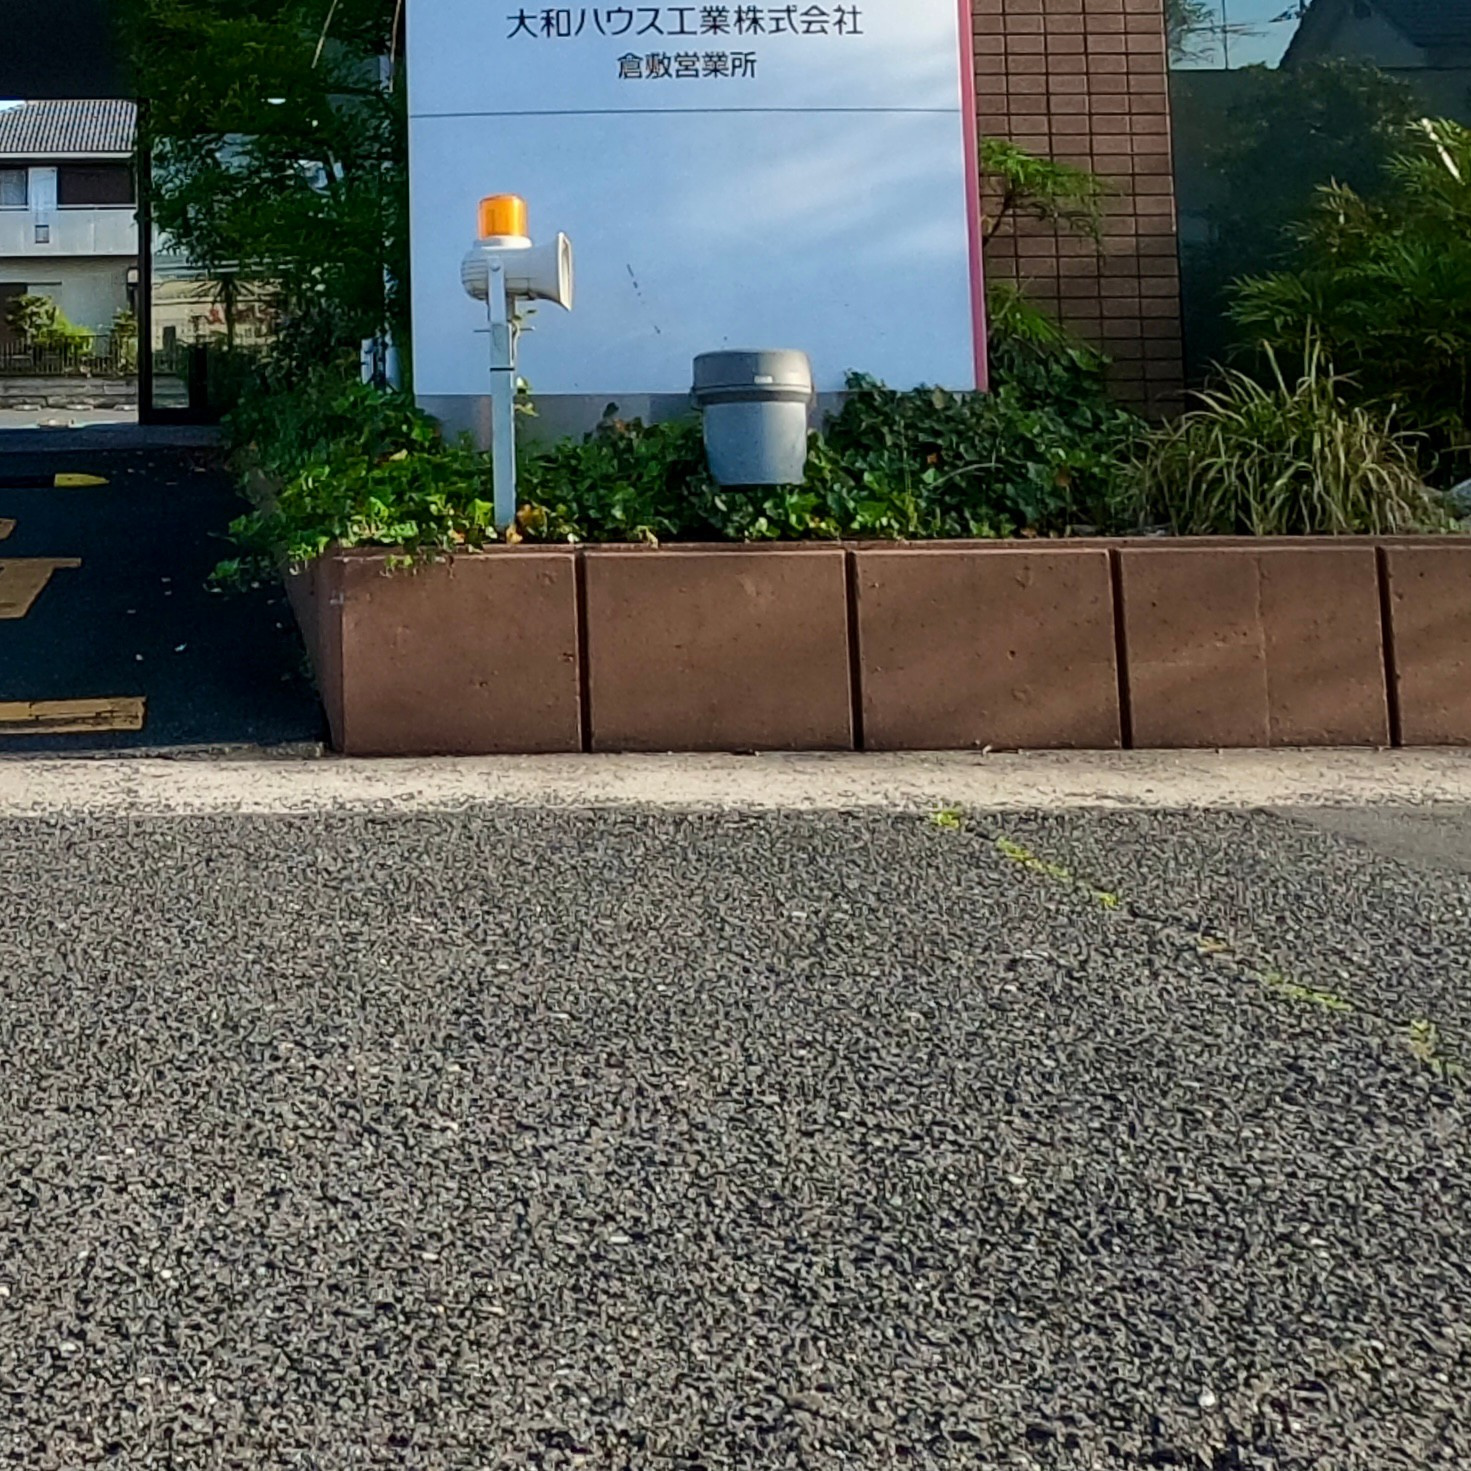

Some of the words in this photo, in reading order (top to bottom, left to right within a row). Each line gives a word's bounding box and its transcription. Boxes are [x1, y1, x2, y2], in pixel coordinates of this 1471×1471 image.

[506, 4, 864, 39] 大和ハウス工業株式会社
[616, 51, 758, 80] 倉敷営業所
